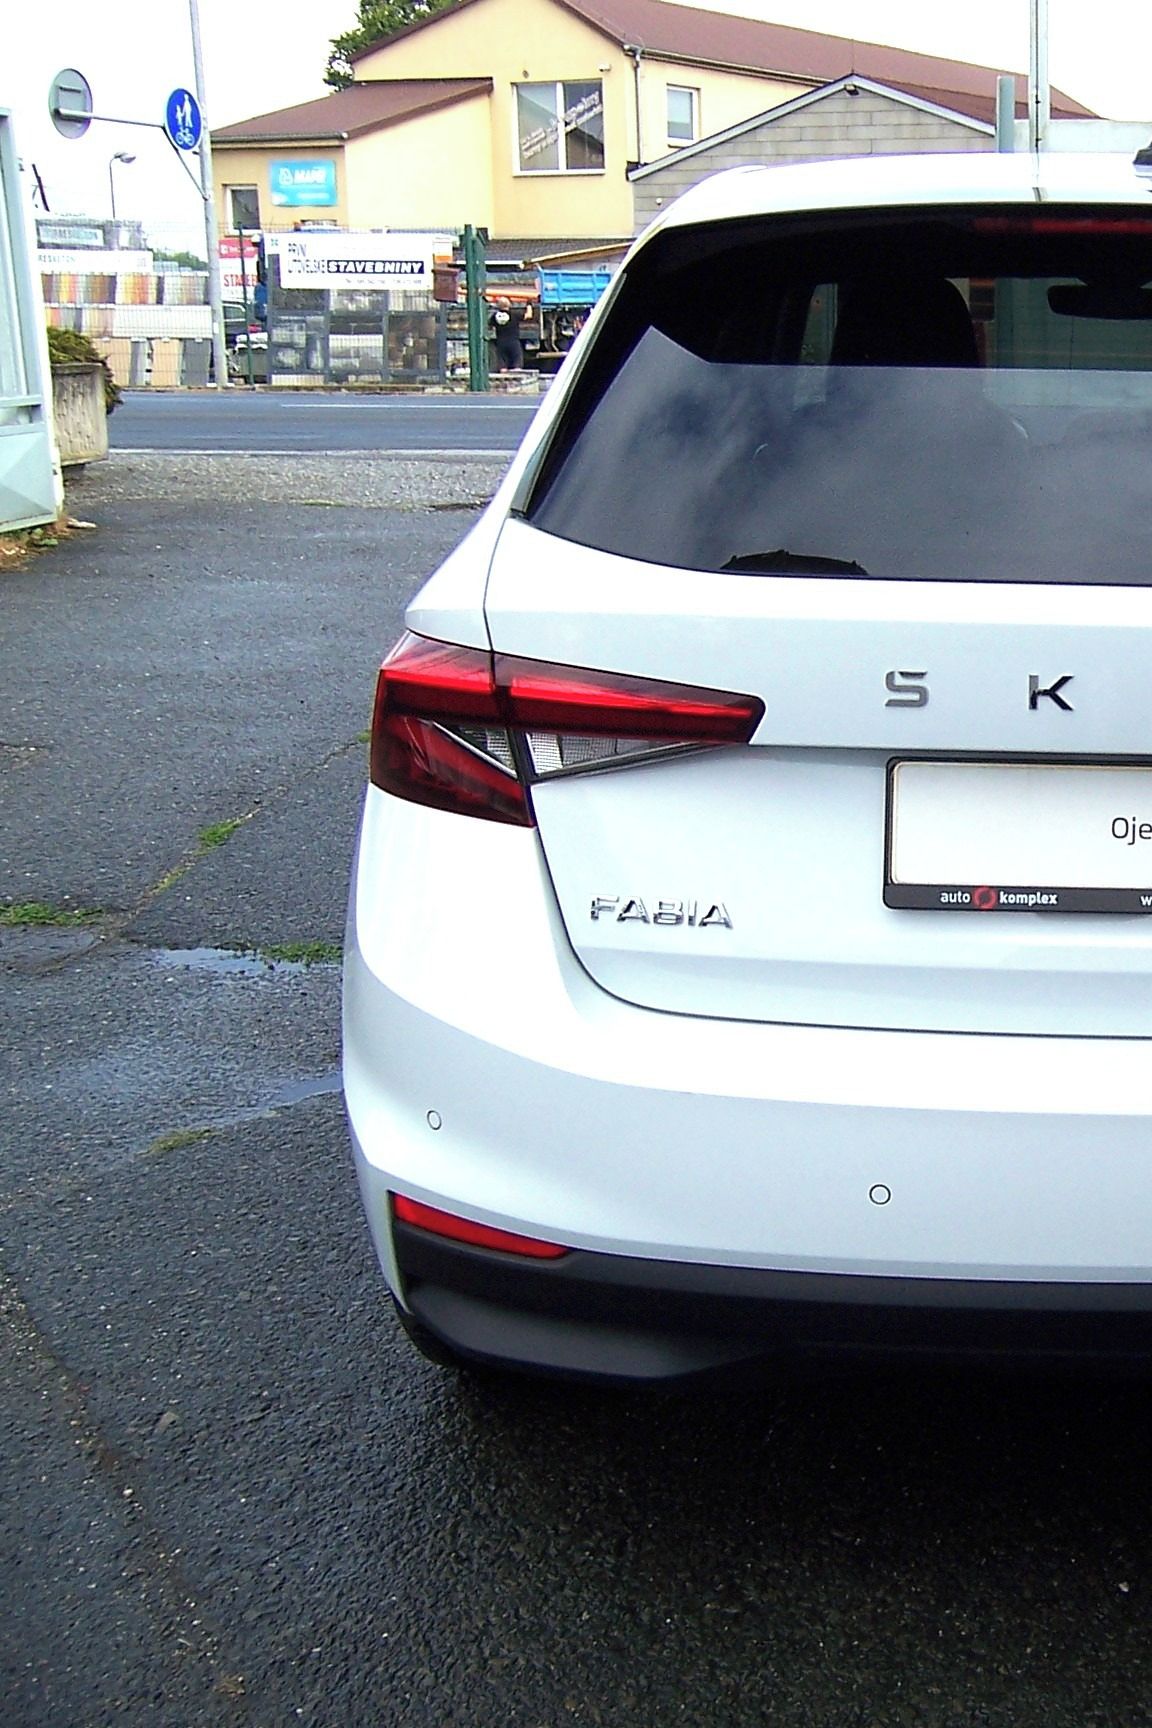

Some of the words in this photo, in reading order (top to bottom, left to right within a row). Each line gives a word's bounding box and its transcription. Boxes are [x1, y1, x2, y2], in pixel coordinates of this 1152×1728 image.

[328, 261, 423, 274] STAVEBNINY
[940, 891, 971, 904] auto
[999, 891, 1058, 907] komplex
[589, 894, 734, 931] FABIA
